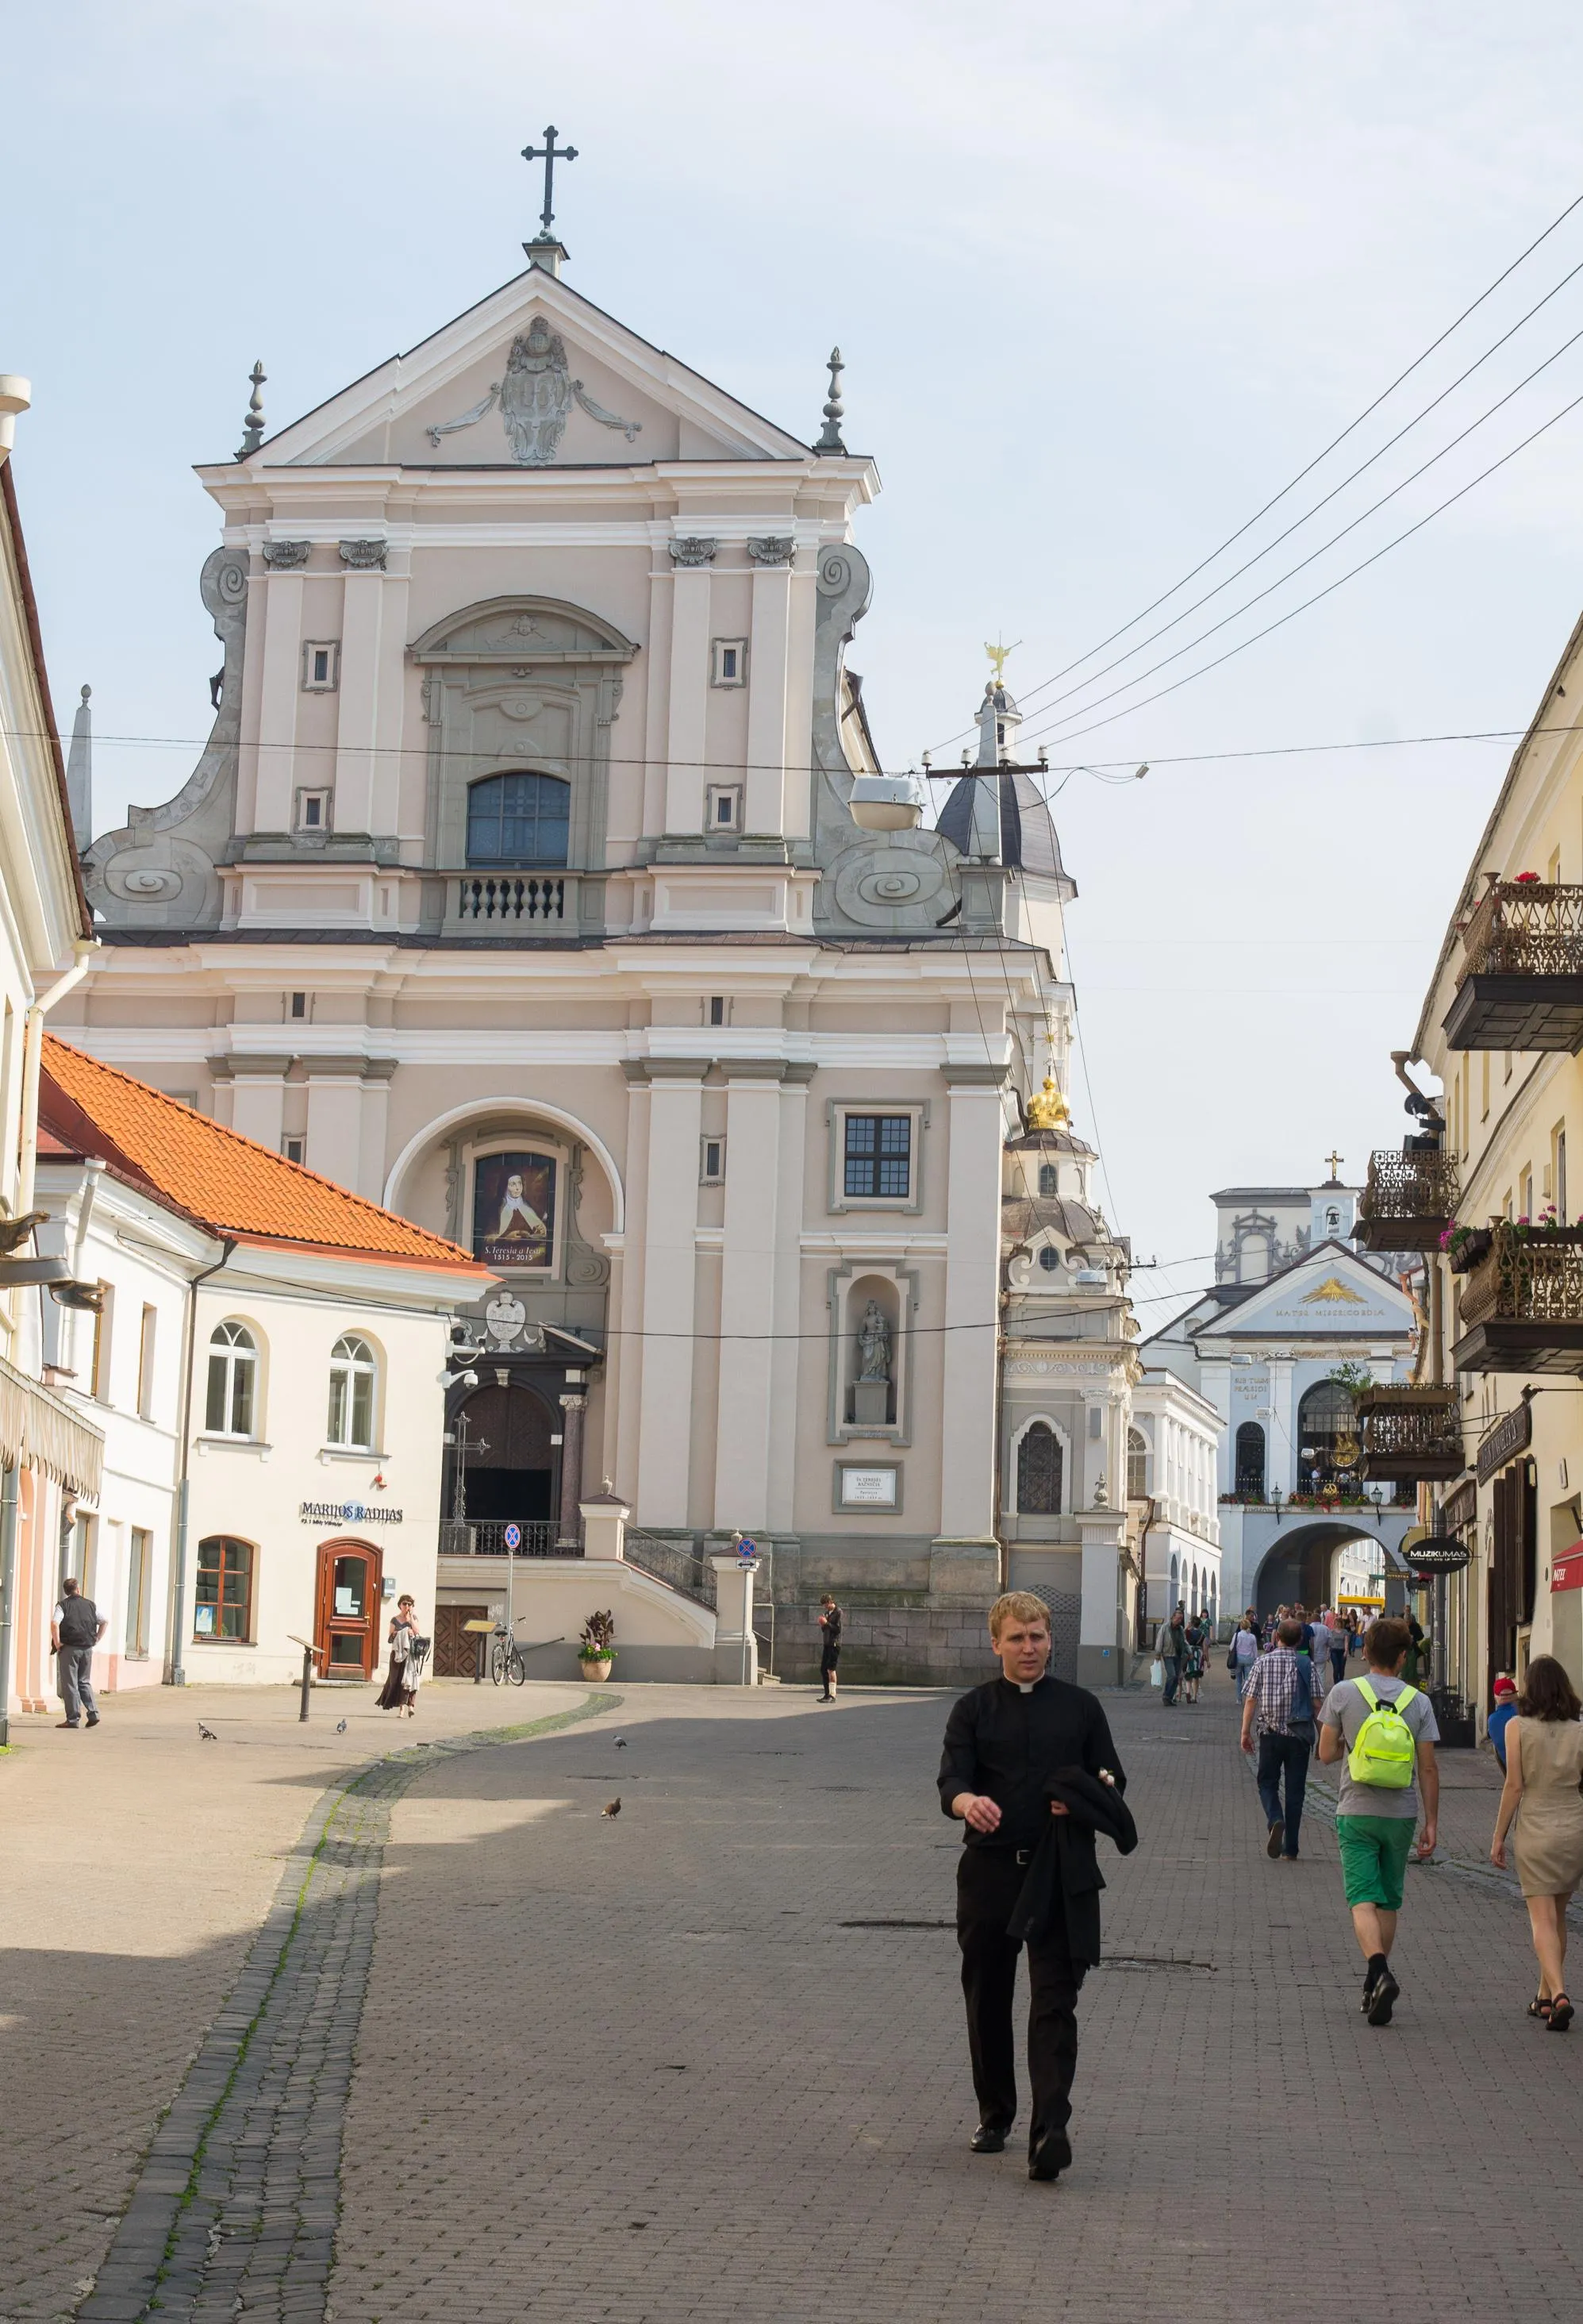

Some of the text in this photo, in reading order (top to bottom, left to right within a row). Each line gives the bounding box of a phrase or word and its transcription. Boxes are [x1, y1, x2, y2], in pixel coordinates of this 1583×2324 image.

[492, 1245, 517, 1254] Teresia
[302, 1502, 403, 1522] MARIJOS RADIJAS
